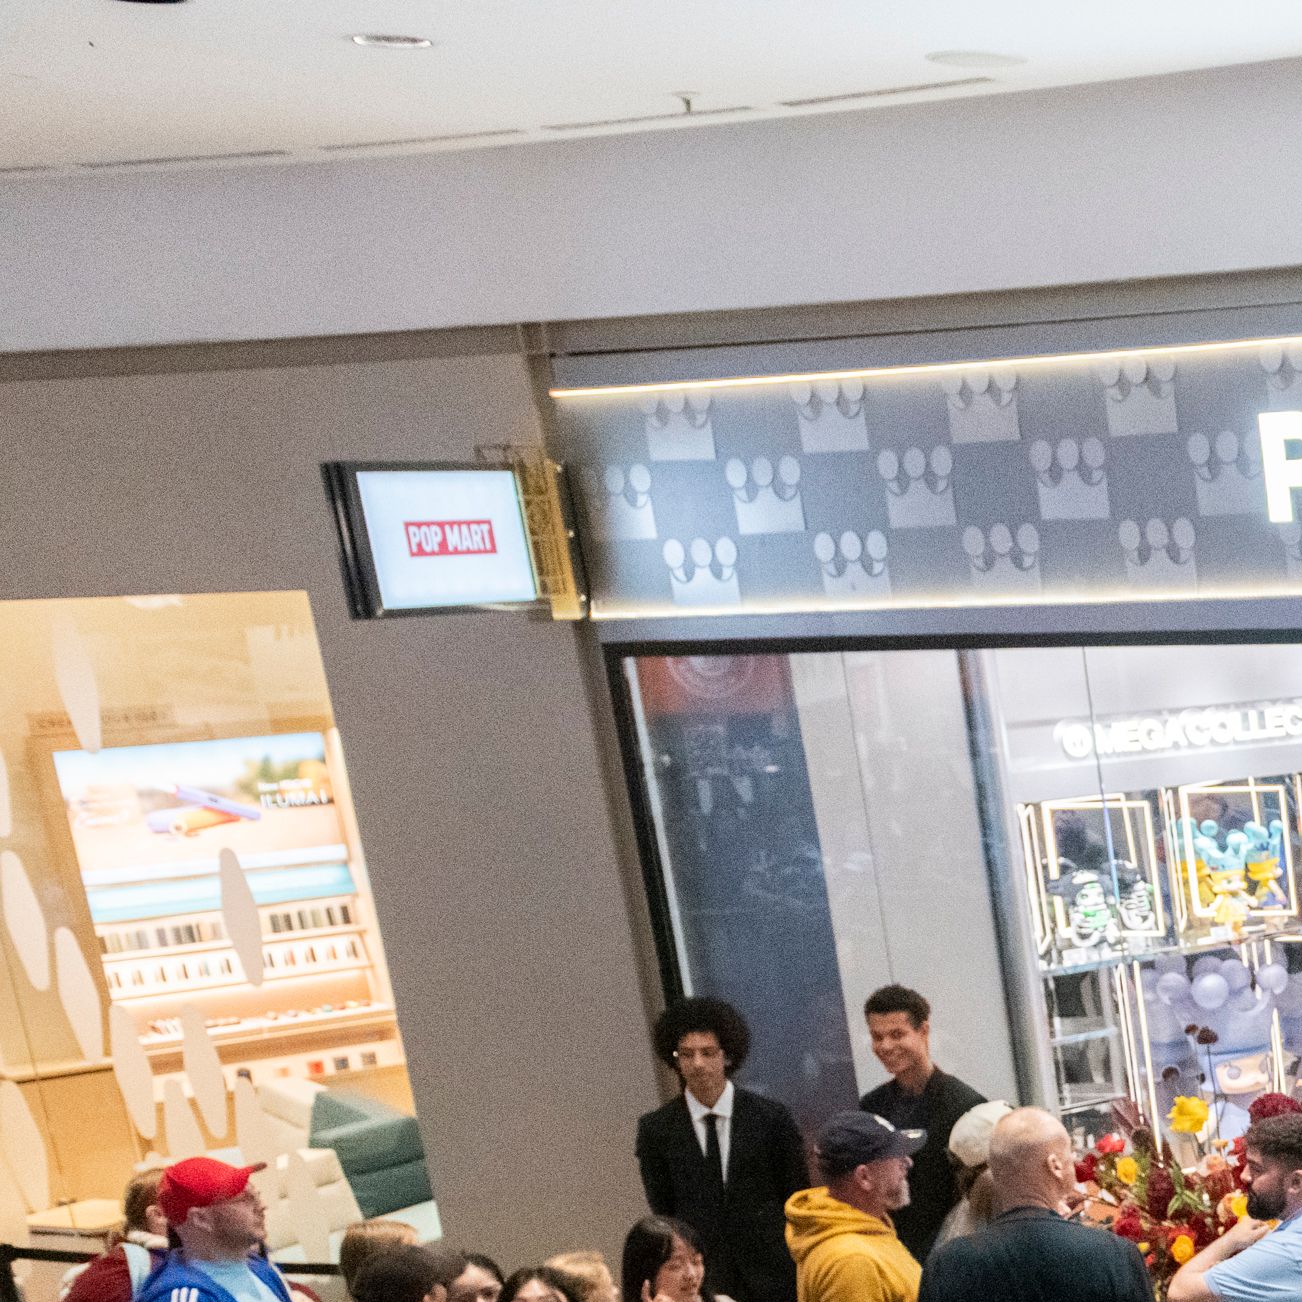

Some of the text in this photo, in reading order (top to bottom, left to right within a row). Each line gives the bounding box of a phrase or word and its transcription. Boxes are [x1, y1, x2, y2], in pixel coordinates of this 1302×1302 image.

[407, 523, 492, 553] POP MART
[1094, 715, 1187, 755] MEGA
